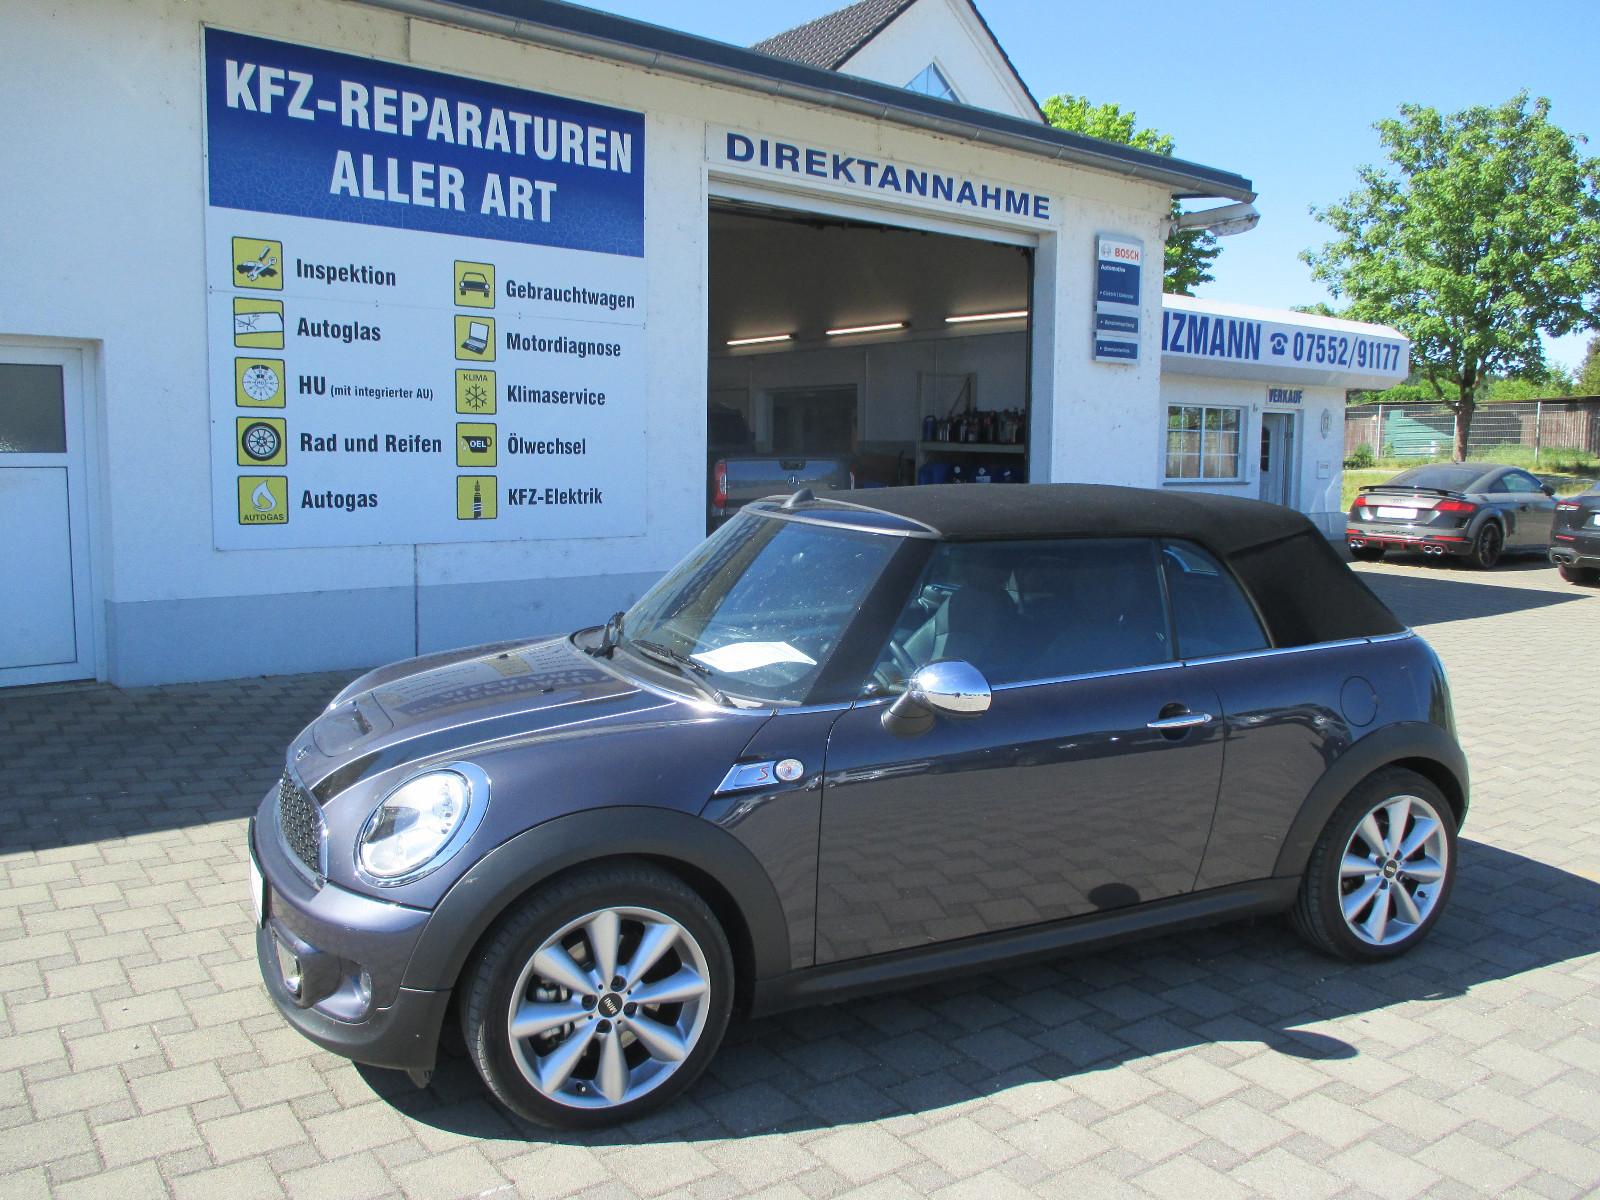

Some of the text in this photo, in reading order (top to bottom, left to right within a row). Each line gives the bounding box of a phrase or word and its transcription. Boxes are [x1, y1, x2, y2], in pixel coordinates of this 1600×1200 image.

[225, 59, 632, 173] KFZ-REPARATUREN
[329, 150, 557, 223] ALLER ART
[726, 132, 1050, 220] DIREKTANNAHME
[1114, 247, 1139, 261] BOSCH
[296, 258, 396, 286] Inspektion
[506, 280, 635, 310] Gebrauchtwagen
[297, 317, 381, 343] Autoglas
[506, 333, 621, 358] Motordiagnose
[1293, 332, 1400, 371] 07552/91177
[299, 375, 434, 401] HU (mit integrierter AU)
[463, 373, 488, 382] KLIMA
[507, 385, 606, 406] Klimaservice
[1269, 388, 1303, 403] VERKAUF
[300, 433, 442, 453] Rad und Reifen
[470, 440, 487, 448] OEL
[507, 433, 586, 455] Ölwechsel
[301, 490, 379, 512] Autogas
[508, 488, 603, 506] KFZ-Elektrik
[243, 513, 284, 521] AUTOGAS
[756, 765, 770, 781] S
[603, 997, 618, 1015] MINI
